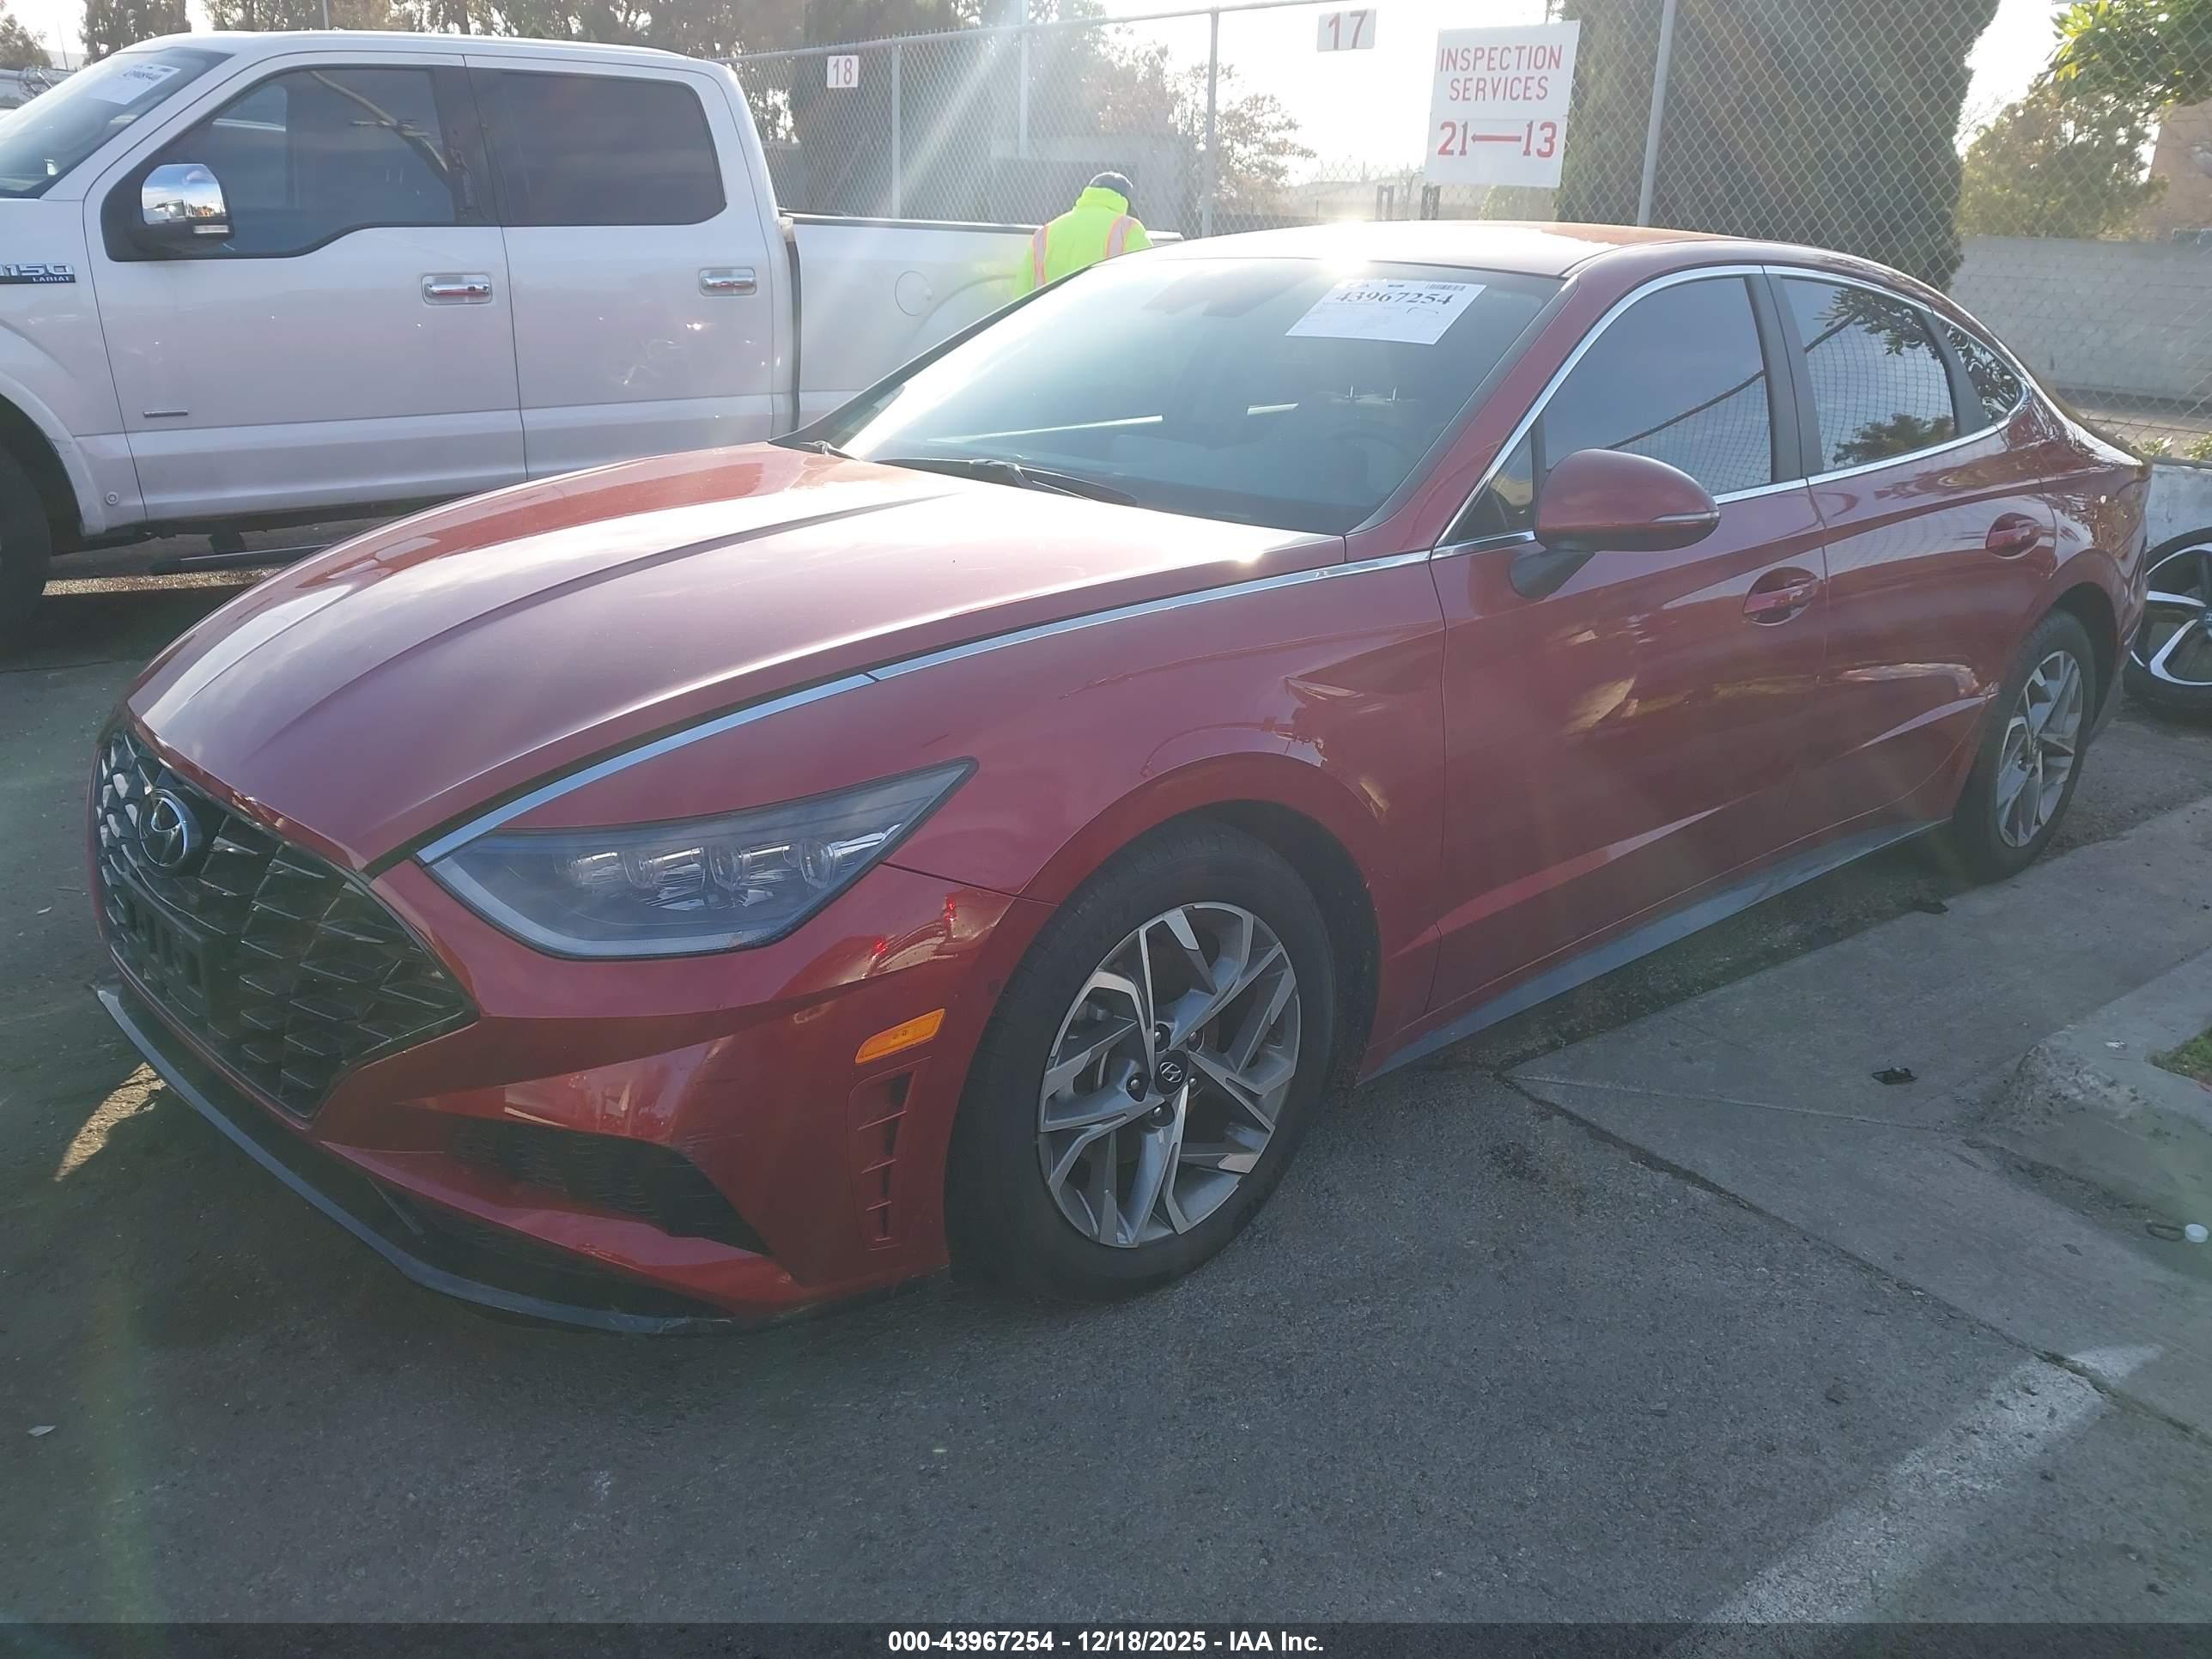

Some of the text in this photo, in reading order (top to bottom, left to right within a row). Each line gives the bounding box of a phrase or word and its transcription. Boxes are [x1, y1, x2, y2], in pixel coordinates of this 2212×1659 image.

[1328, 9, 1367, 51] 17
[834, 58, 853, 85] 18
[1440, 45, 1563, 72] INSPECTION
[1449, 76, 1548, 101] SERVICES
[1437, 120, 1557, 158] 21 13
[1334, 290, 1454, 307] 43967254
